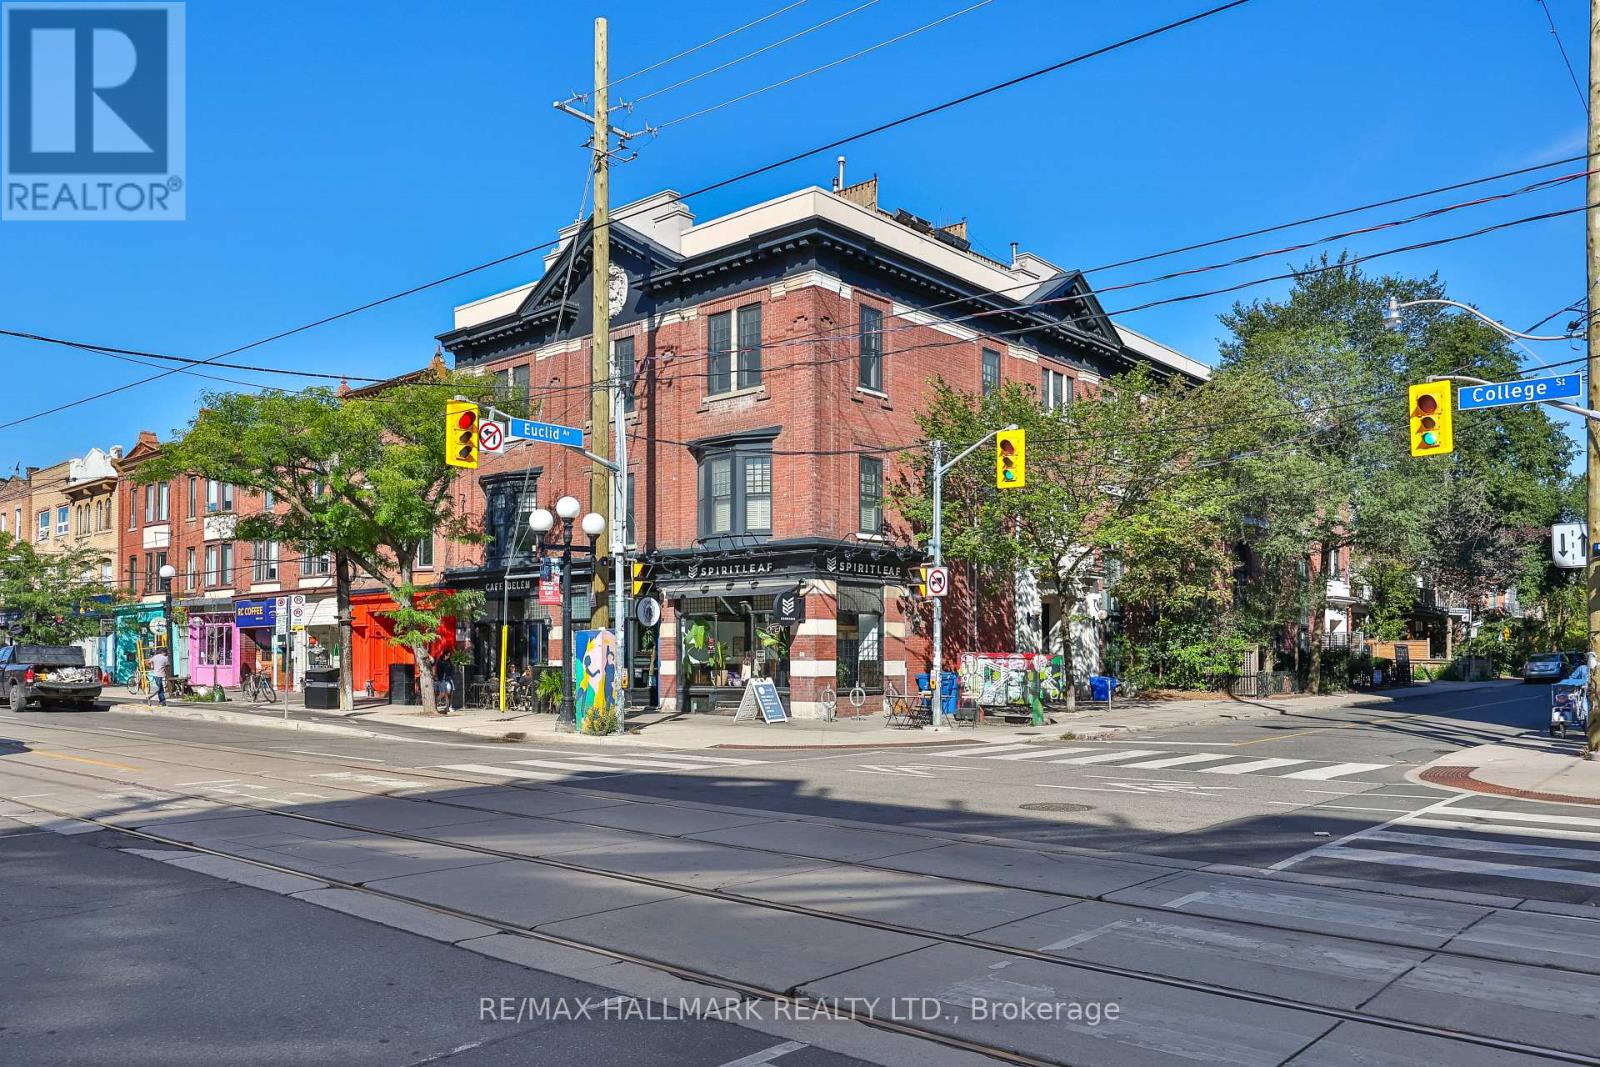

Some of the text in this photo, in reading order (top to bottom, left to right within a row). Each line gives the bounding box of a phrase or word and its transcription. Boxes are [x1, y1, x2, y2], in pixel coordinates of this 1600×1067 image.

[1472, 378, 1566, 402] College St
[524, 423, 559, 440] Euclid
[700, 562, 773, 576] SPIRITLEAF
[839, 561, 901, 576] SPIRITLEAF
[244, 606, 264, 616] COFFEE
